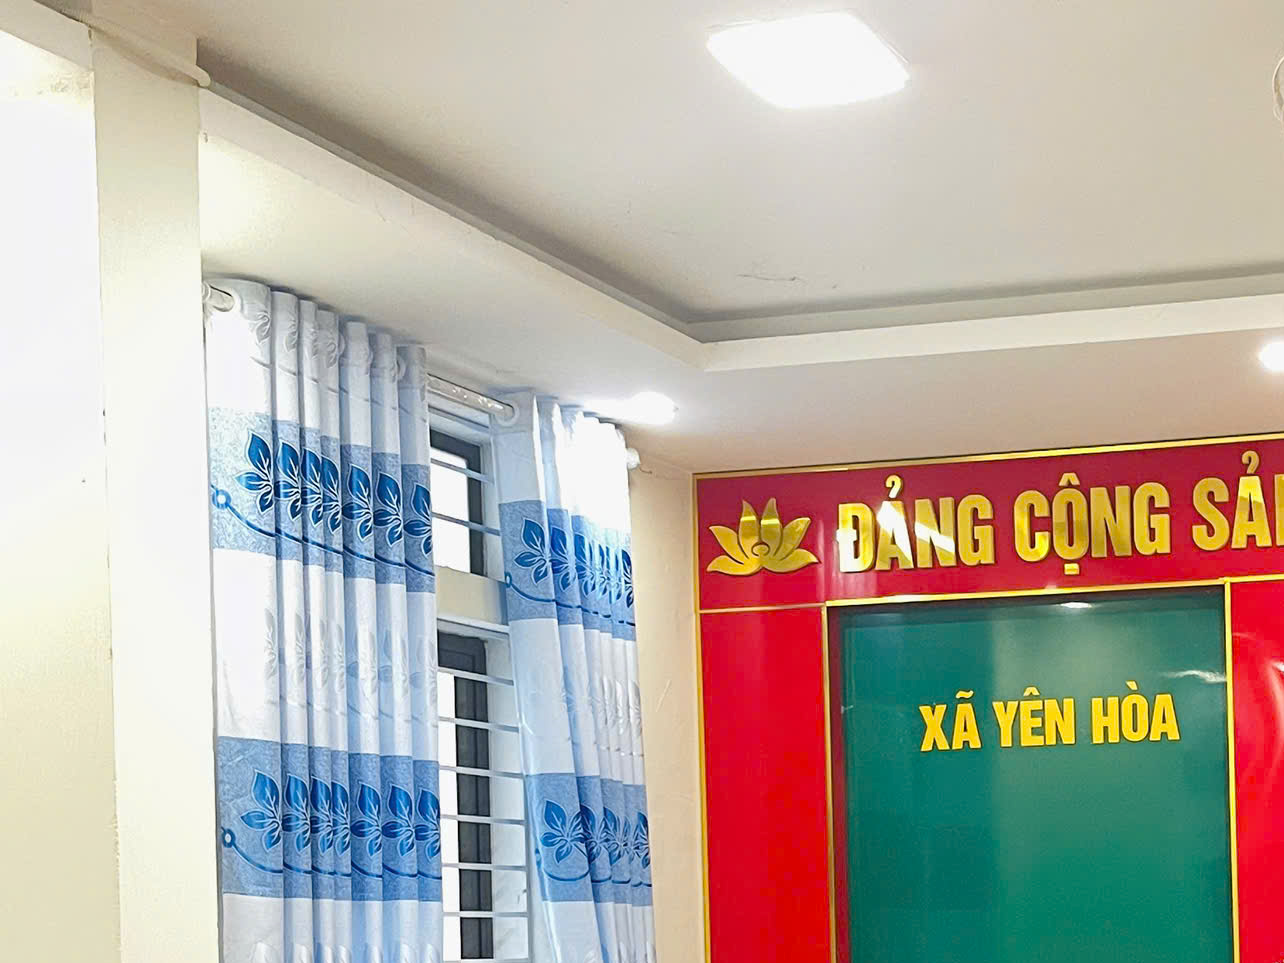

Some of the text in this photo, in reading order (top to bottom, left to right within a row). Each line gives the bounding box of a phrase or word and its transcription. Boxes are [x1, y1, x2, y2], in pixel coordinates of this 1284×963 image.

[836, 475, 995, 573] ĐẢNG
[1014, 472, 1170, 575] CỘNG
[919, 680, 1181, 752] XÃ YÊN HÒA
